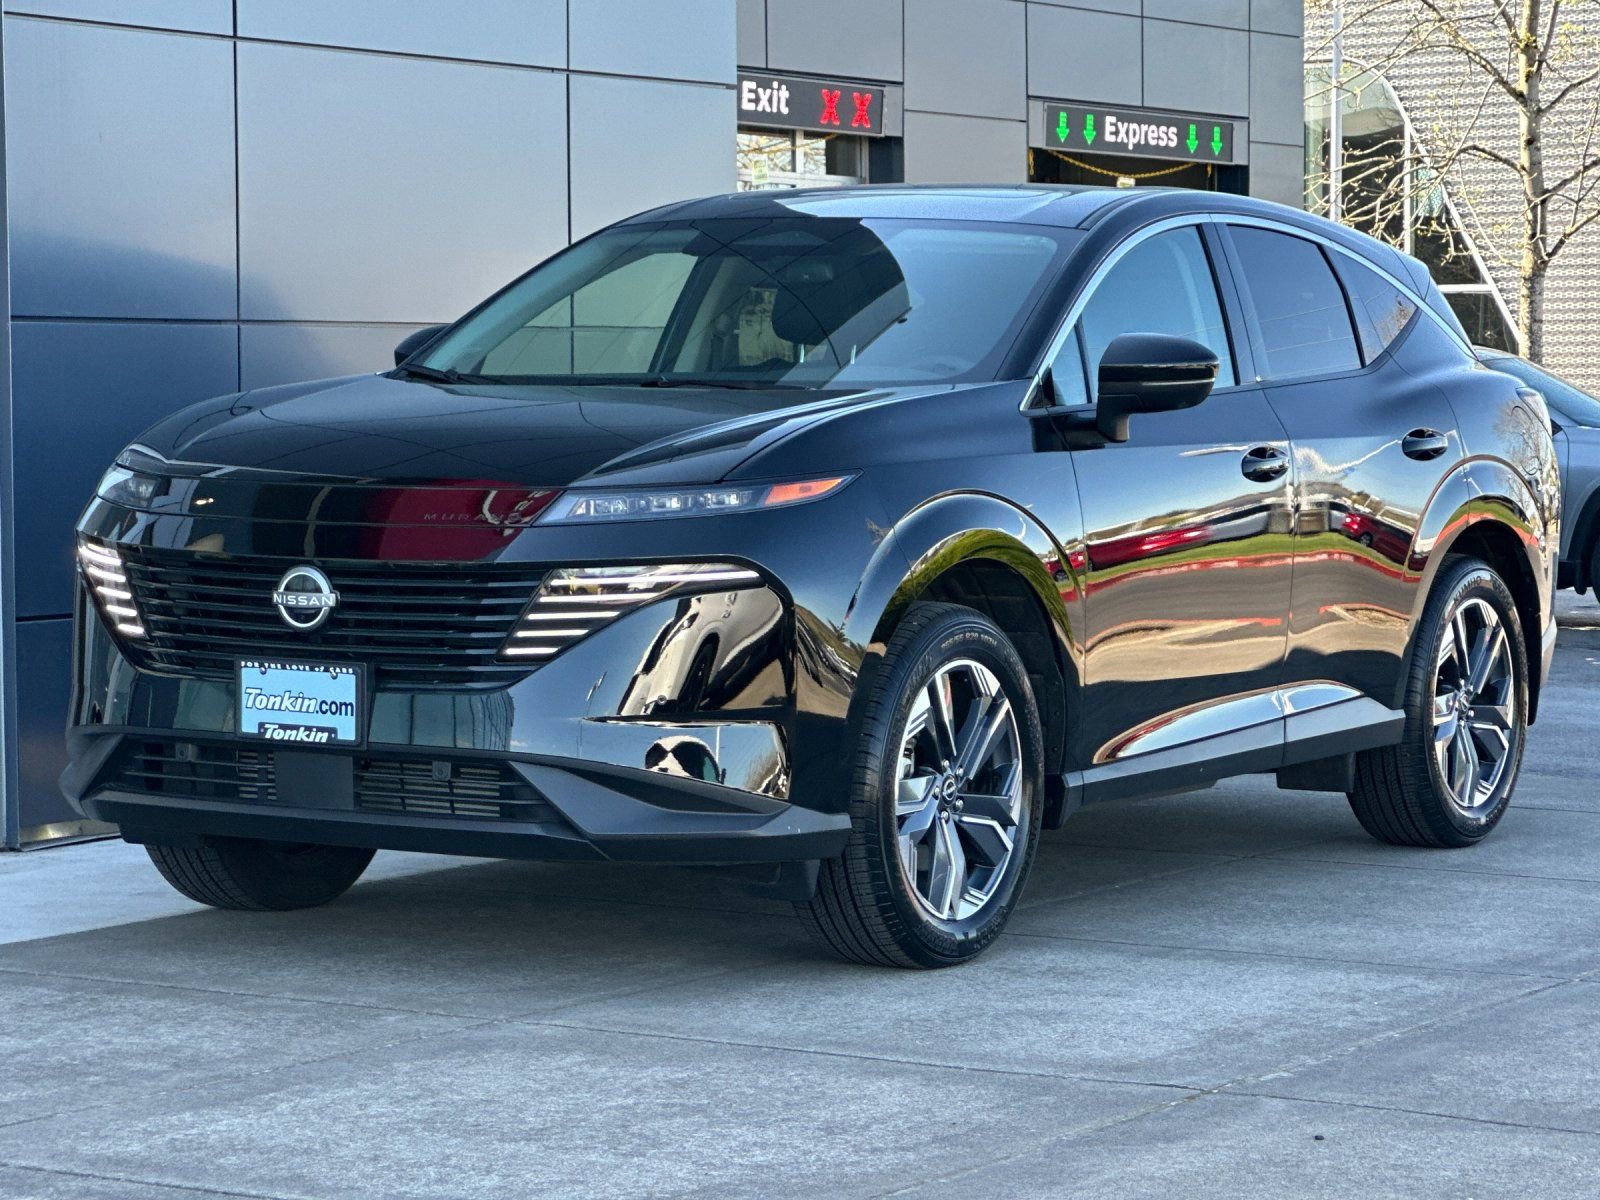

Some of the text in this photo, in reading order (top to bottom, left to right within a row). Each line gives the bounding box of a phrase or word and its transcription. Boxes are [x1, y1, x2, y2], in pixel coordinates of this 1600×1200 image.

[741, 80, 790, 115] Exit
[1104, 115, 1178, 150] Express
[273, 593, 333, 606] NISSAN
[1453, 575, 1482, 604] KUMHO
[264, 662, 281, 670] THE
[286, 664, 310, 672] LOVE
[245, 687, 355, 717] Tonkin.com
[264, 723, 329, 743] Tonkin
